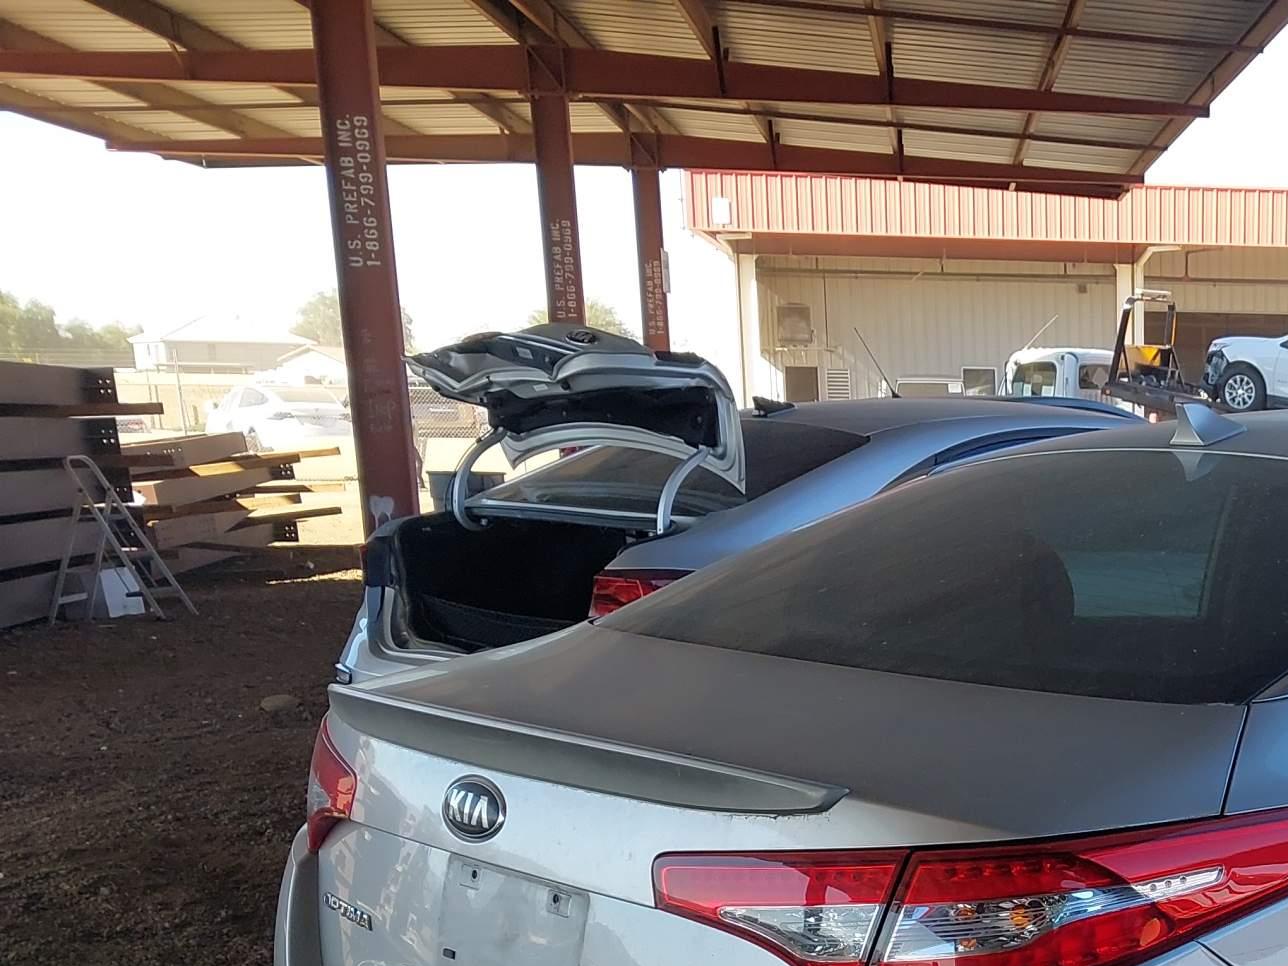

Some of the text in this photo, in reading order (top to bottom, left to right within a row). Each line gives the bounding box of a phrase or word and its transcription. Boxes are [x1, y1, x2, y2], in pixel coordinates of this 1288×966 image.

[336, 114, 364, 267] U.S. PREFAB INC.
[353, 115, 381, 267] 1-866-799-0969
[550, 218, 561, 241] INC.
[551, 246, 564, 290] PREFAB
[449, 788, 490, 829] KIA
